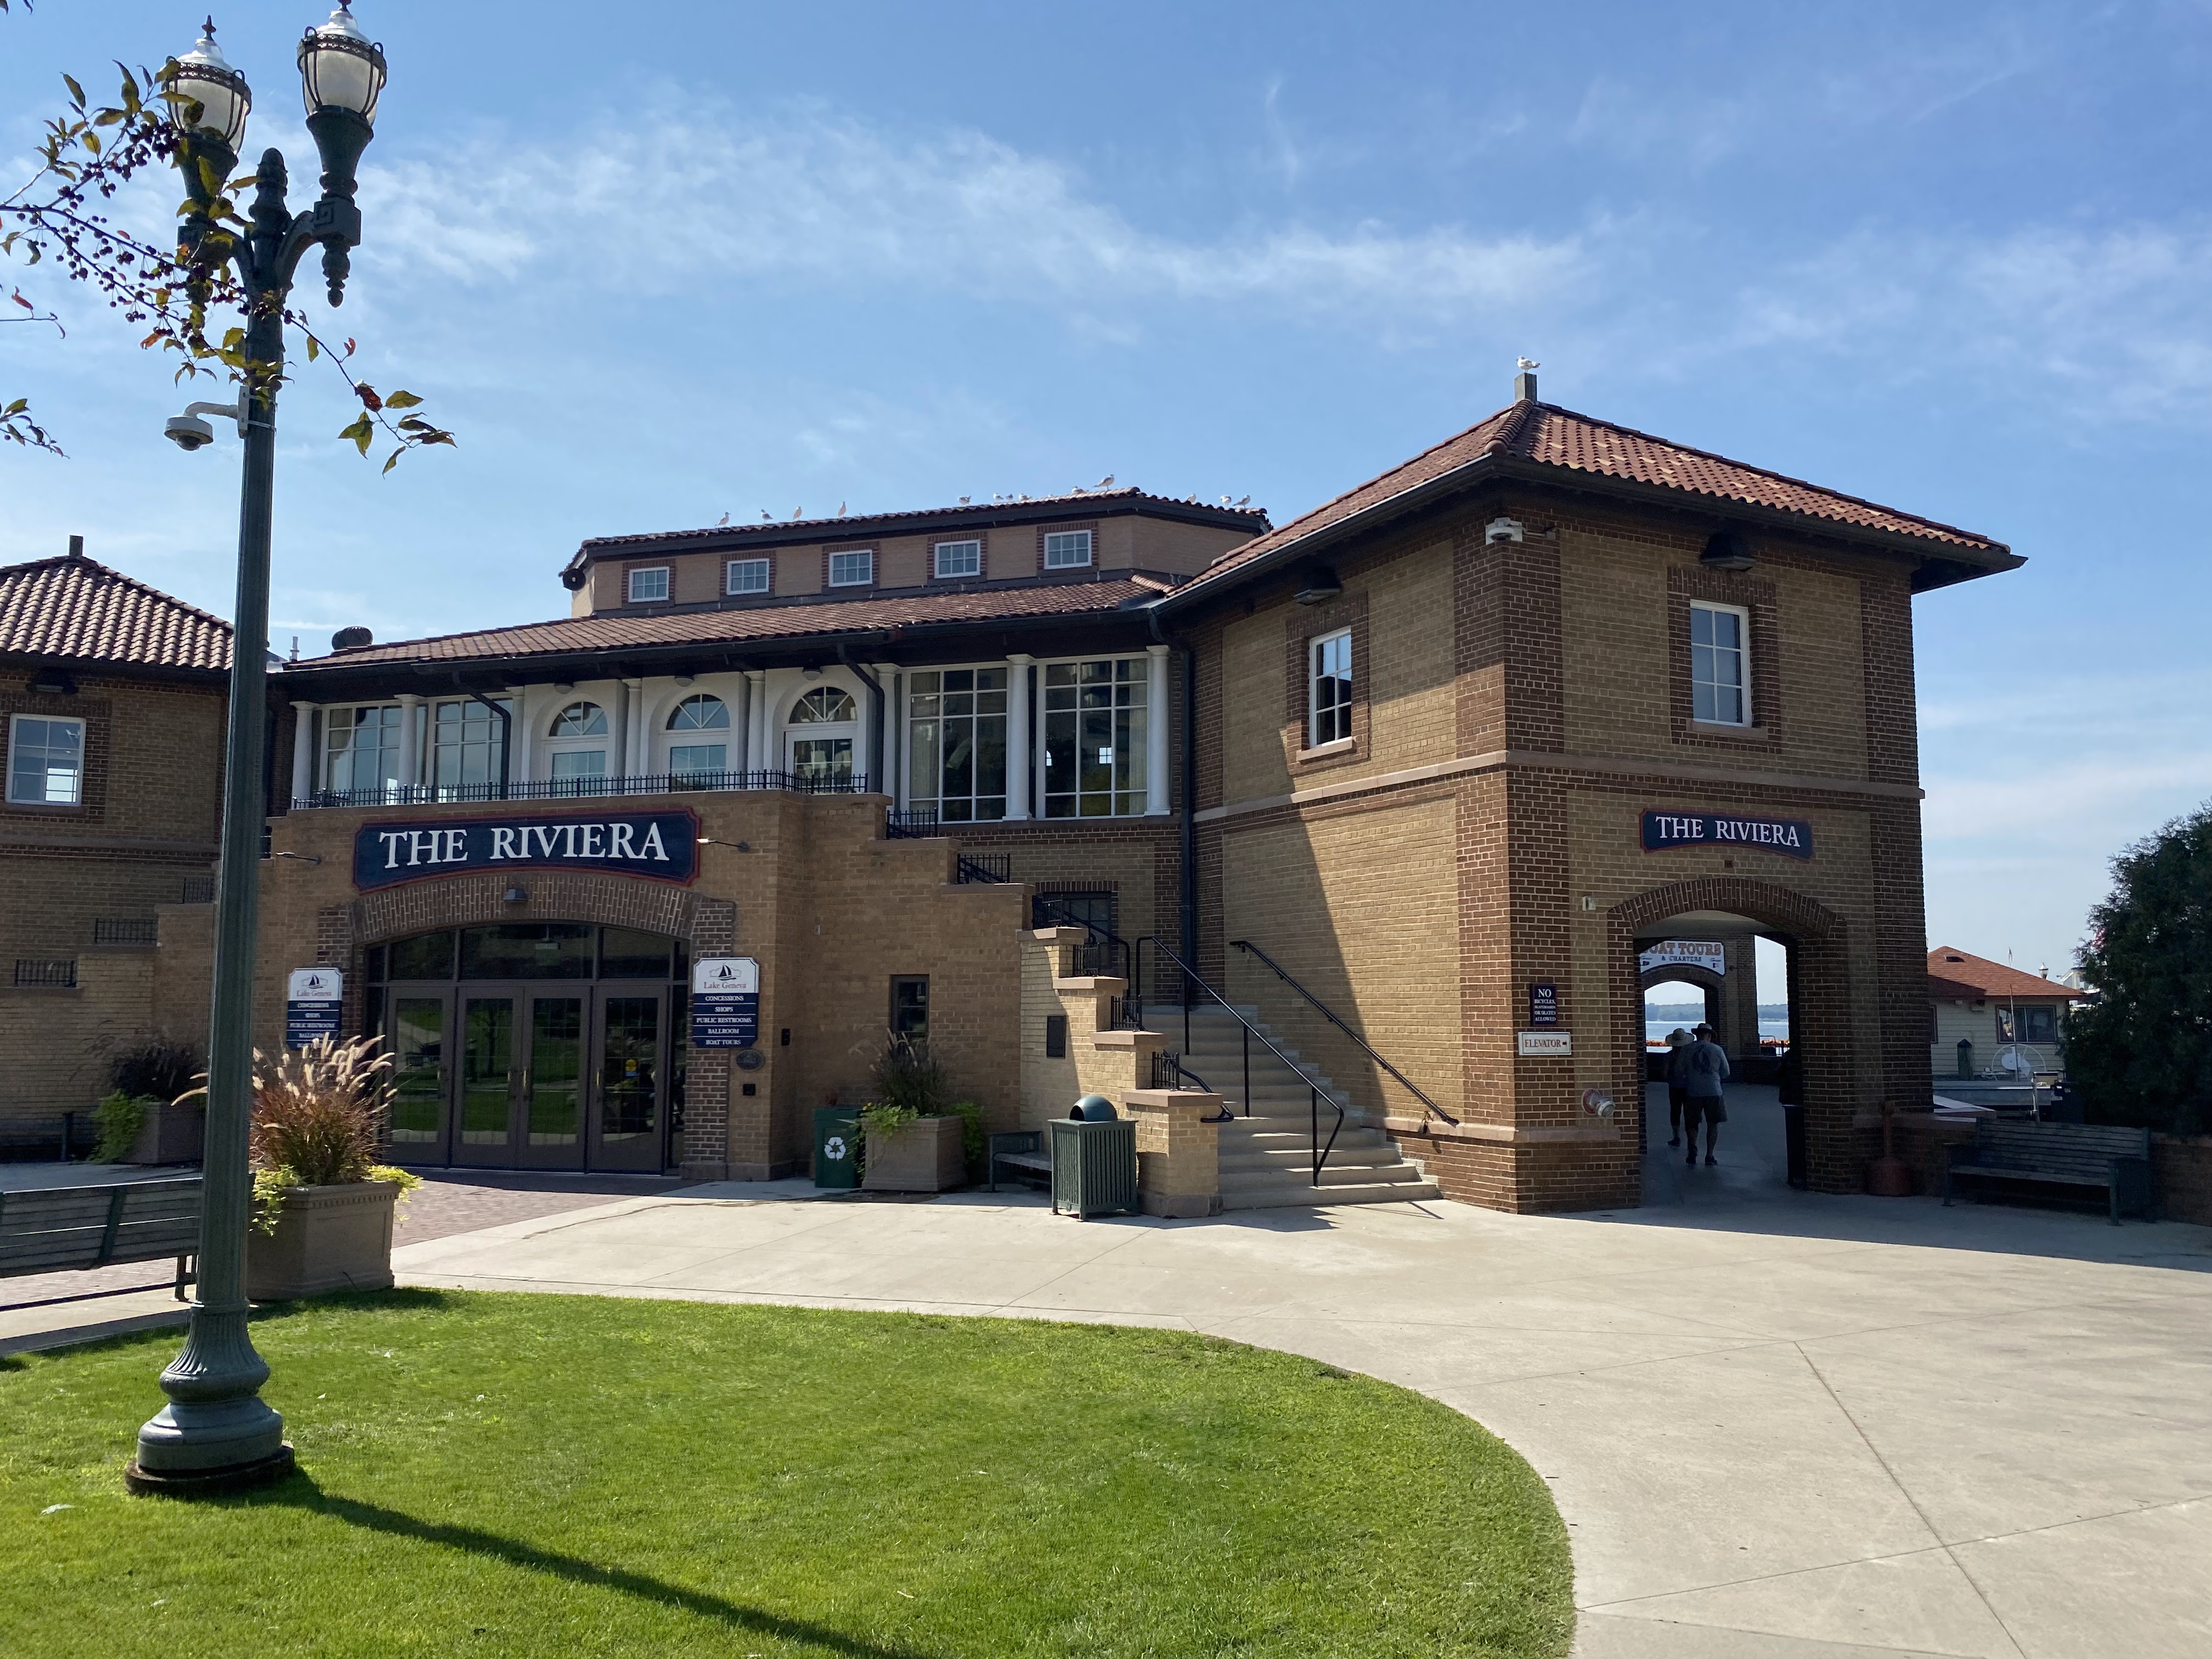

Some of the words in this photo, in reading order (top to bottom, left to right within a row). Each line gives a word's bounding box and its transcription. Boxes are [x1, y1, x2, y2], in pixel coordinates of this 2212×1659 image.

[1655, 816, 1705, 838] THE
[1715, 820, 1800, 847] RIVIERA
[379, 829, 468, 869] THE
[489, 822, 669, 861] RIVIERA
[1642, 942, 1675, 954] OAT
[1678, 943, 1721, 956] TOURS
[1538, 989, 1551, 997] NO
[1525, 1039, 1561, 1047] ELEVATOR
